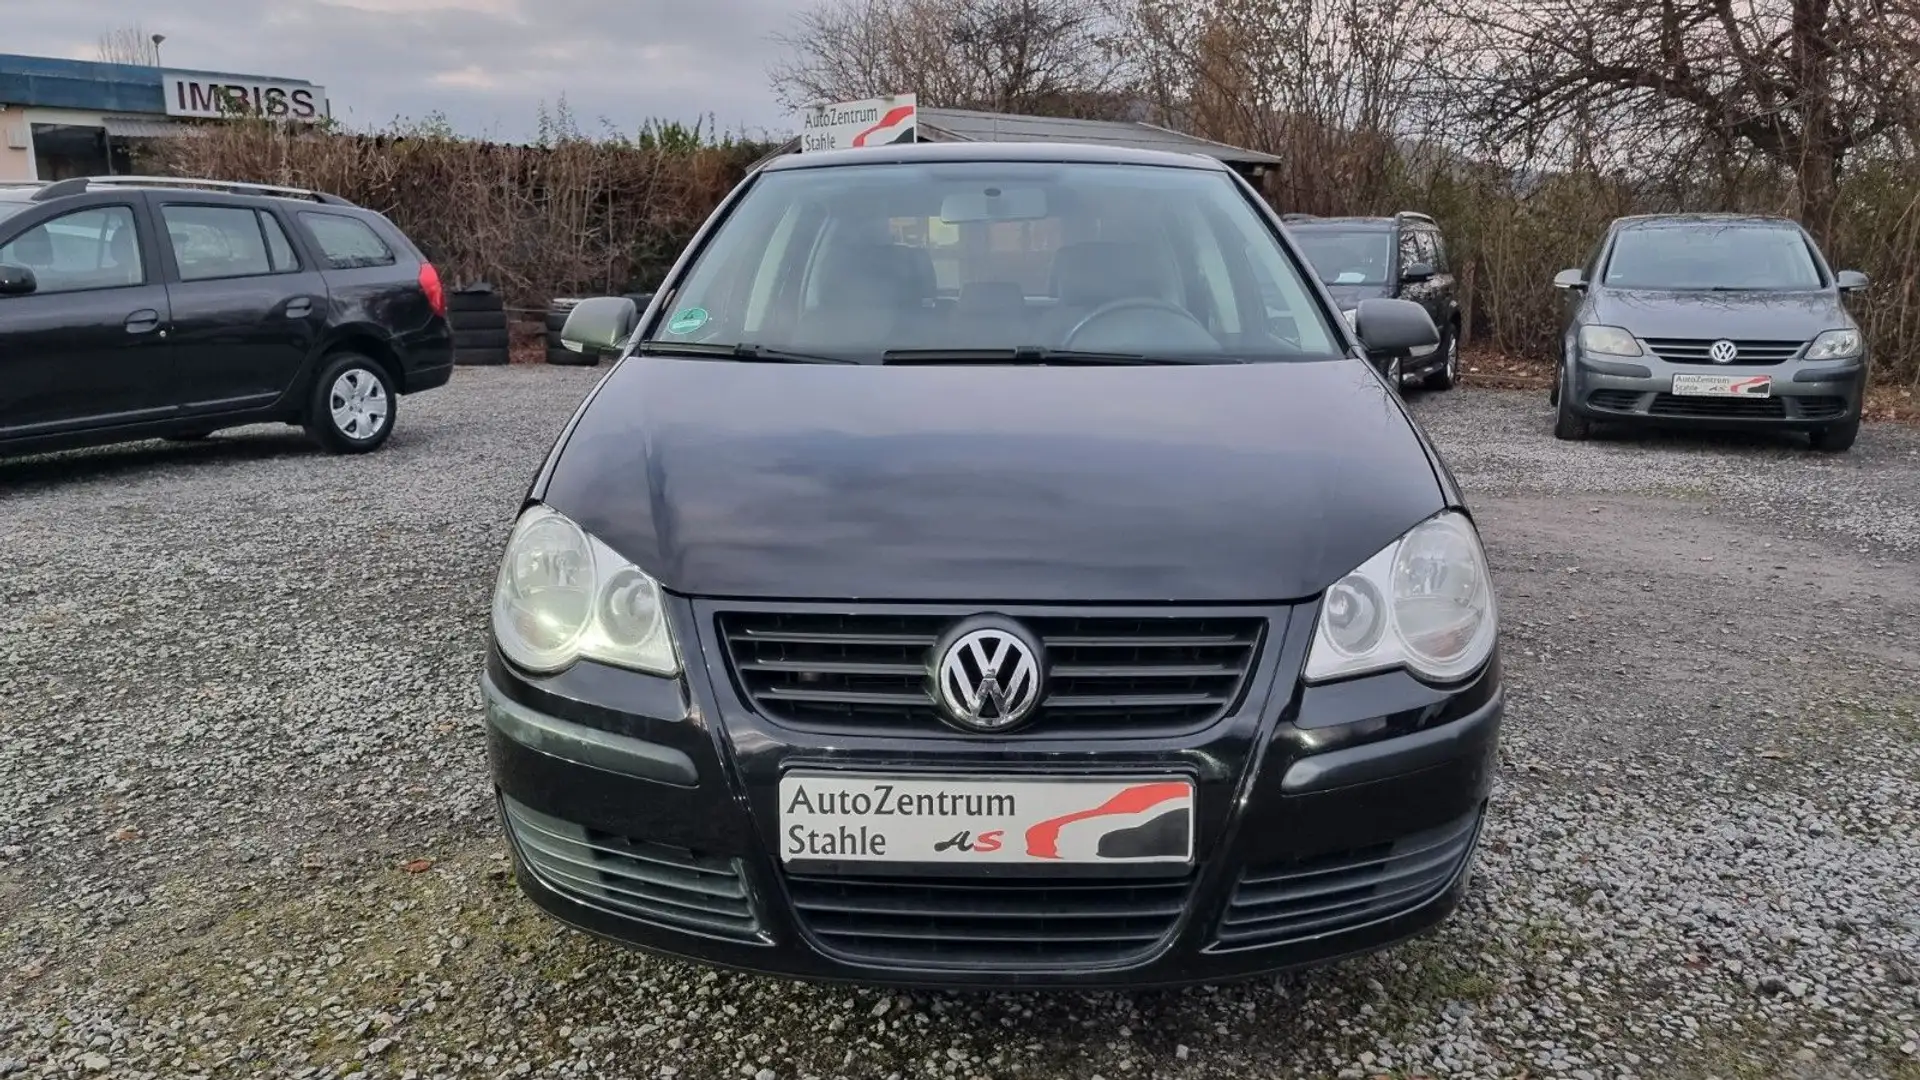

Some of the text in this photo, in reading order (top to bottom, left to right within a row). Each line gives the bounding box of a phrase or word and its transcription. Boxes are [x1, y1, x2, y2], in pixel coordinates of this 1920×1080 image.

[804, 107, 878, 129] AutoZentrum
[805, 132, 836, 151] Stahle
[941, 629, 1038, 727] VW
[786, 785, 1016, 816] AutoZentrum
[787, 825, 1005, 856] Stahle AS
